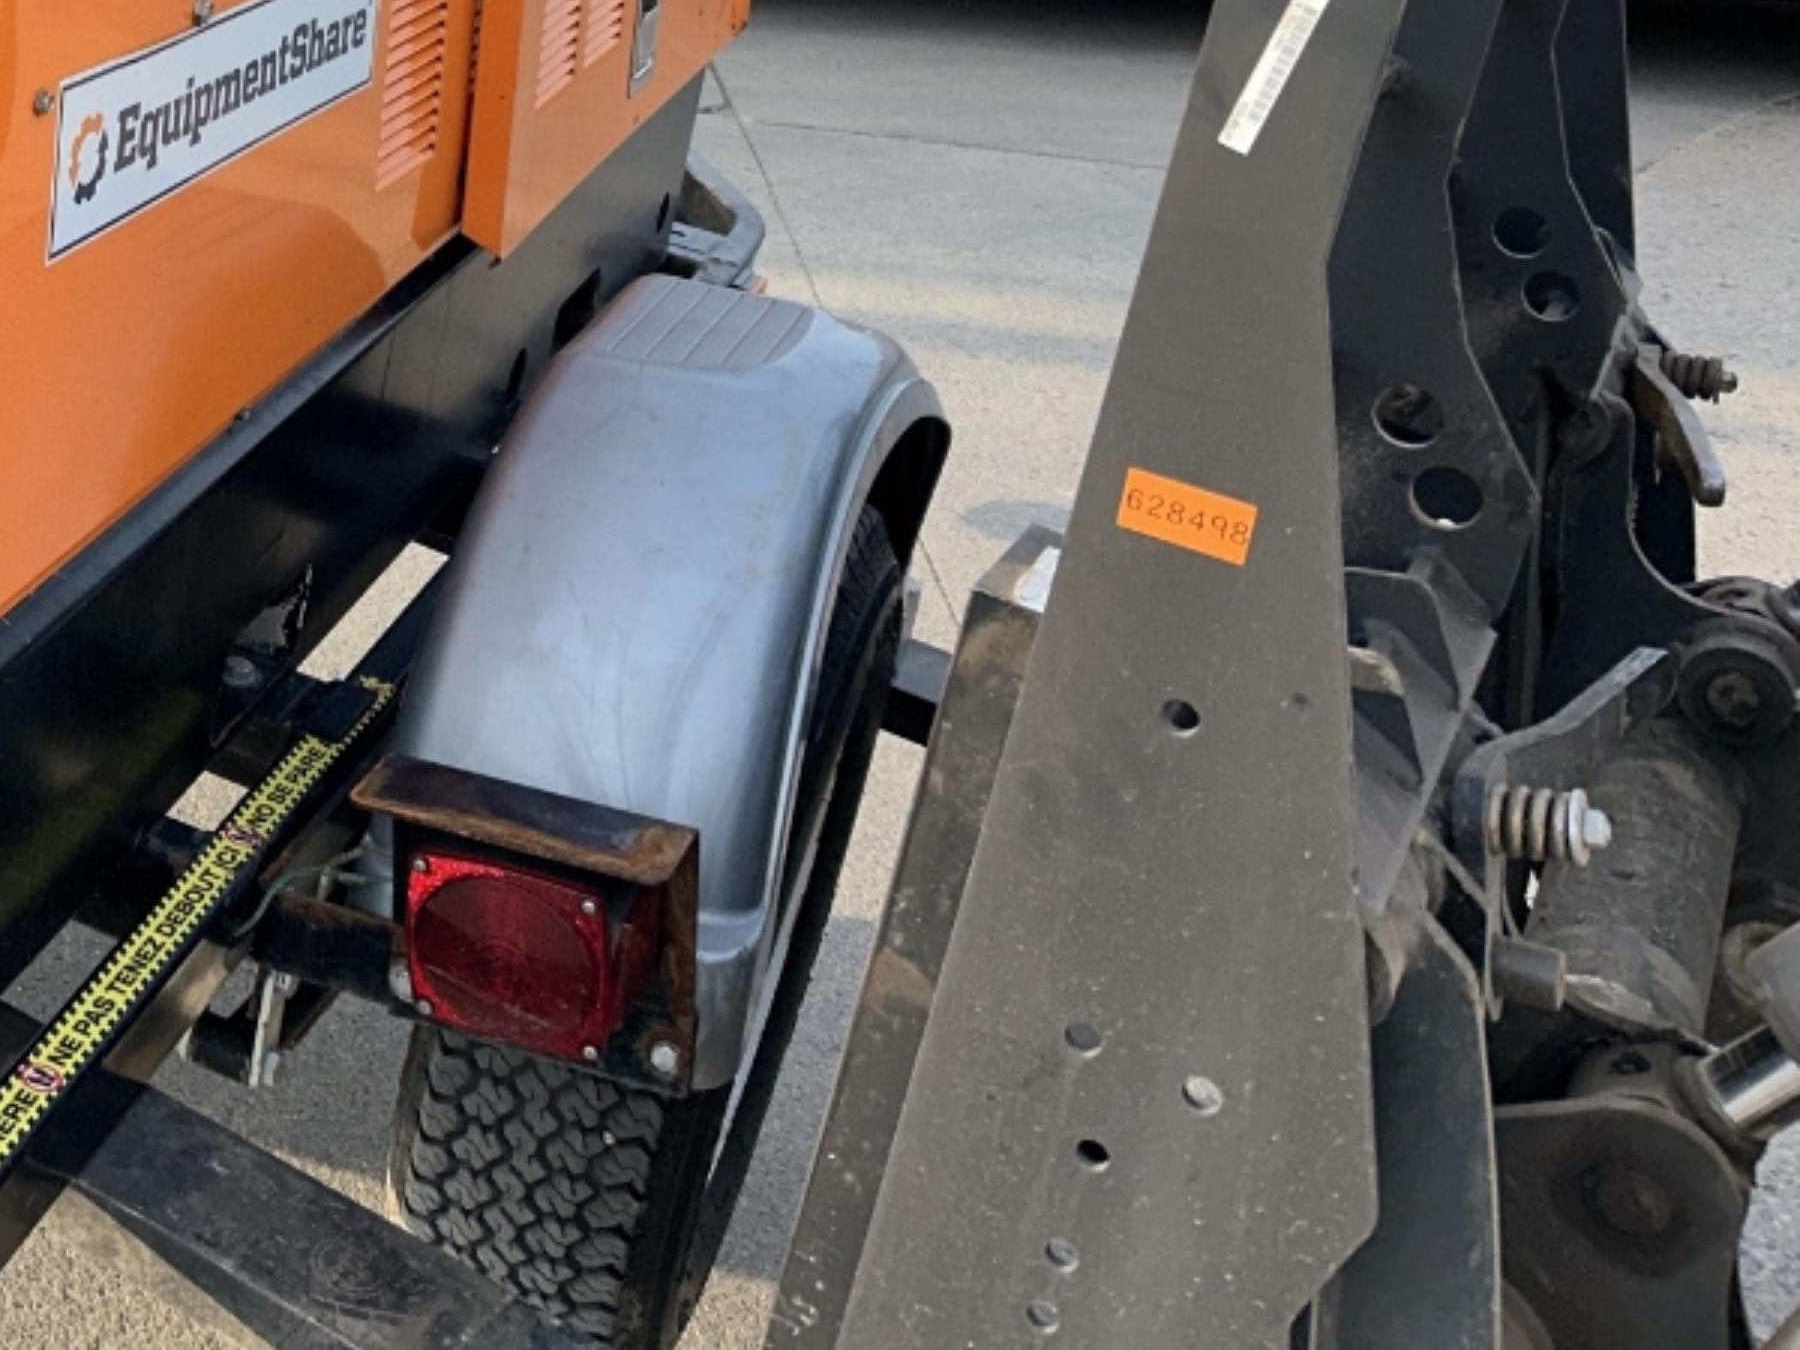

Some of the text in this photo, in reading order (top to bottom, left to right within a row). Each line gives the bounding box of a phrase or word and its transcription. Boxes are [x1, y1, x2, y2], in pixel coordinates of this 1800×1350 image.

[114, 6, 368, 173] EquipmentShare
[1126, 487, 1250, 547] 628498
[252, 743, 323, 828] NO SE PARE
[52, 846, 239, 1067] NE PAS TENEZ DEBOUT ICI
